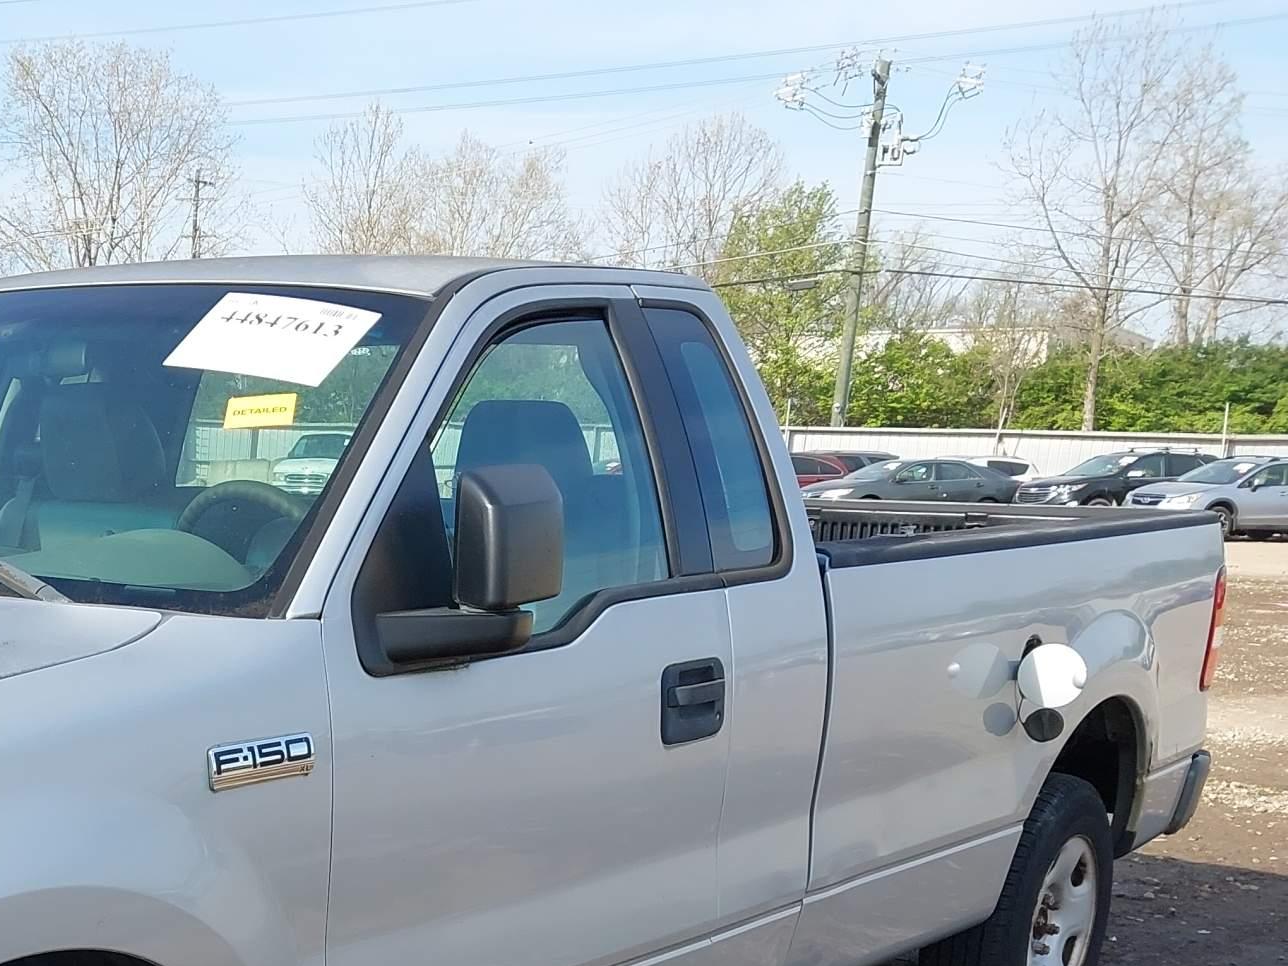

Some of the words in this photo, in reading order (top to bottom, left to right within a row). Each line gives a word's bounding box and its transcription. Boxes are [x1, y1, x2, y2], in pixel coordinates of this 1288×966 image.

[221, 310, 344, 337] 44847613
[232, 406, 287, 416] DETAILED
[213, 736, 312, 776] F-150
